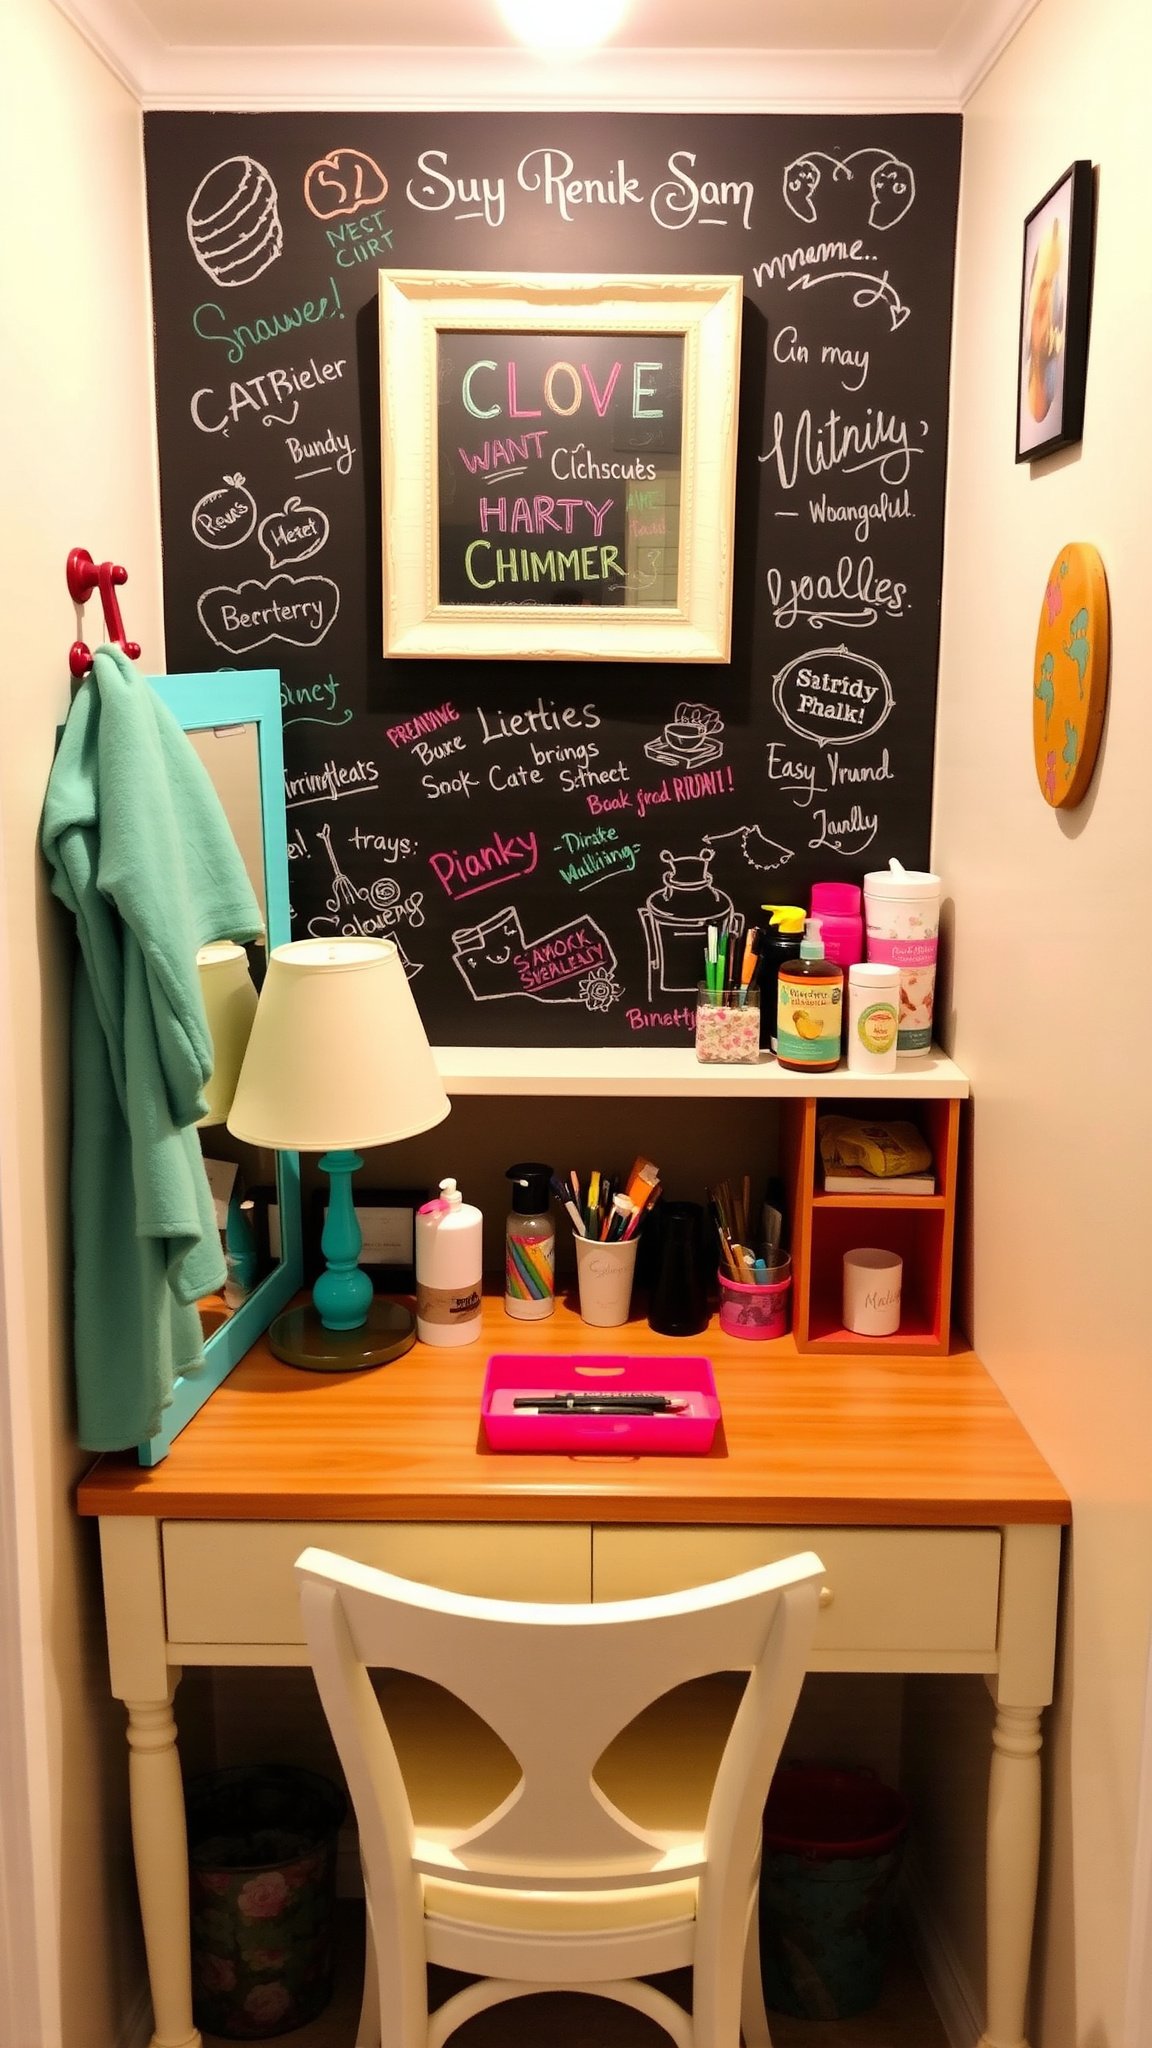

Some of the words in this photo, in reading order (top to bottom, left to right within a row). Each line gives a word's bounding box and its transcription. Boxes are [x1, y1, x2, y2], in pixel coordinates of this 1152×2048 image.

[517, 148, 645, 222] Renik
[650, 151, 754, 231] Sam
[462, 360, 664, 419] CLOVE
[285, 429, 357, 475] Bundy
[459, 430, 549, 474] WANT
[479, 495, 614, 536] HARTY
[465, 539, 629, 590] CHIMMER
[766, 742, 816, 808] Easy
